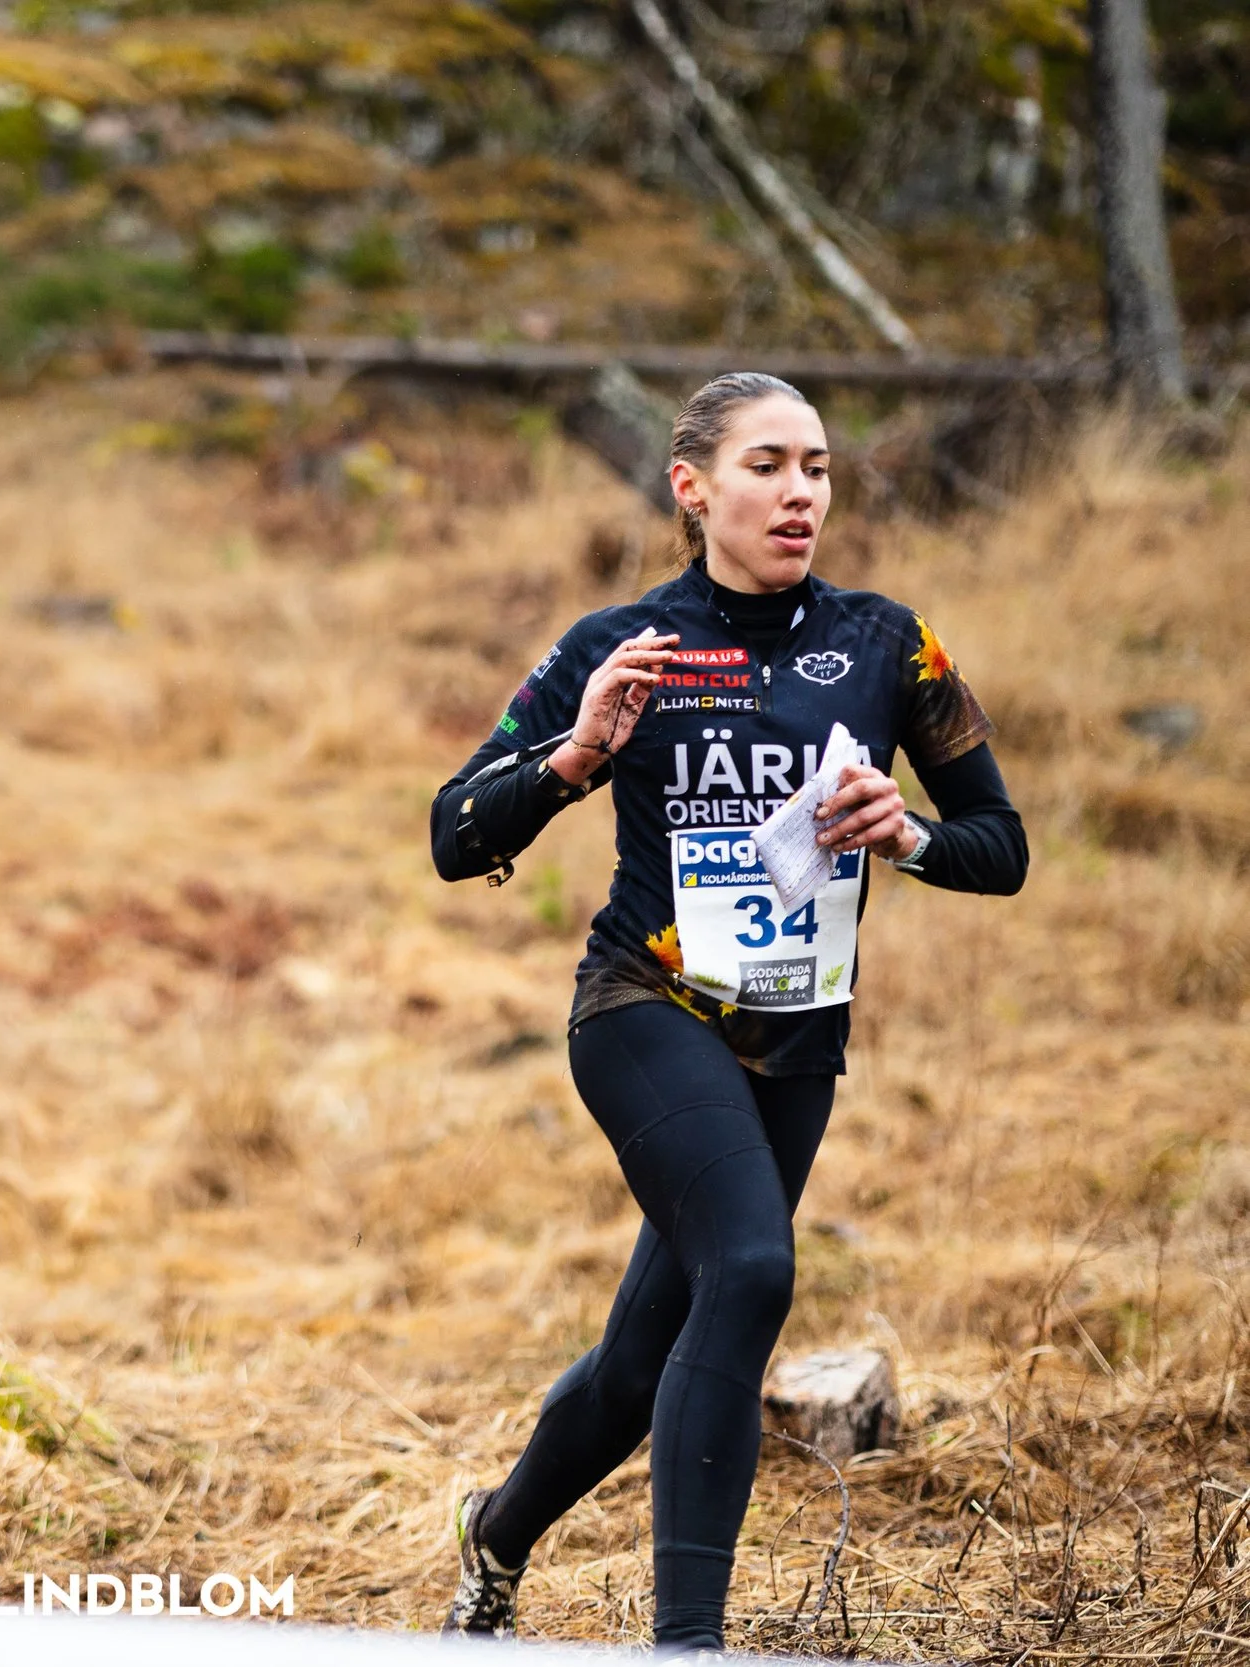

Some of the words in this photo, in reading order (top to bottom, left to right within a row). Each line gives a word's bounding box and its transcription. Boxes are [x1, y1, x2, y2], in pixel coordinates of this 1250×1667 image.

[671, 650, 745, 663] AUHAUS
[658, 673, 751, 687] mercur
[661, 696, 755, 710] LUMONITE
[665, 798, 787, 825] ORIENT
[701, 871, 771, 885] KOLMÅRDSME
[734, 894, 819, 948] 34
[746, 964, 811, 979] GODKÄNDA
[746, 975, 810, 993] AVLOPP
